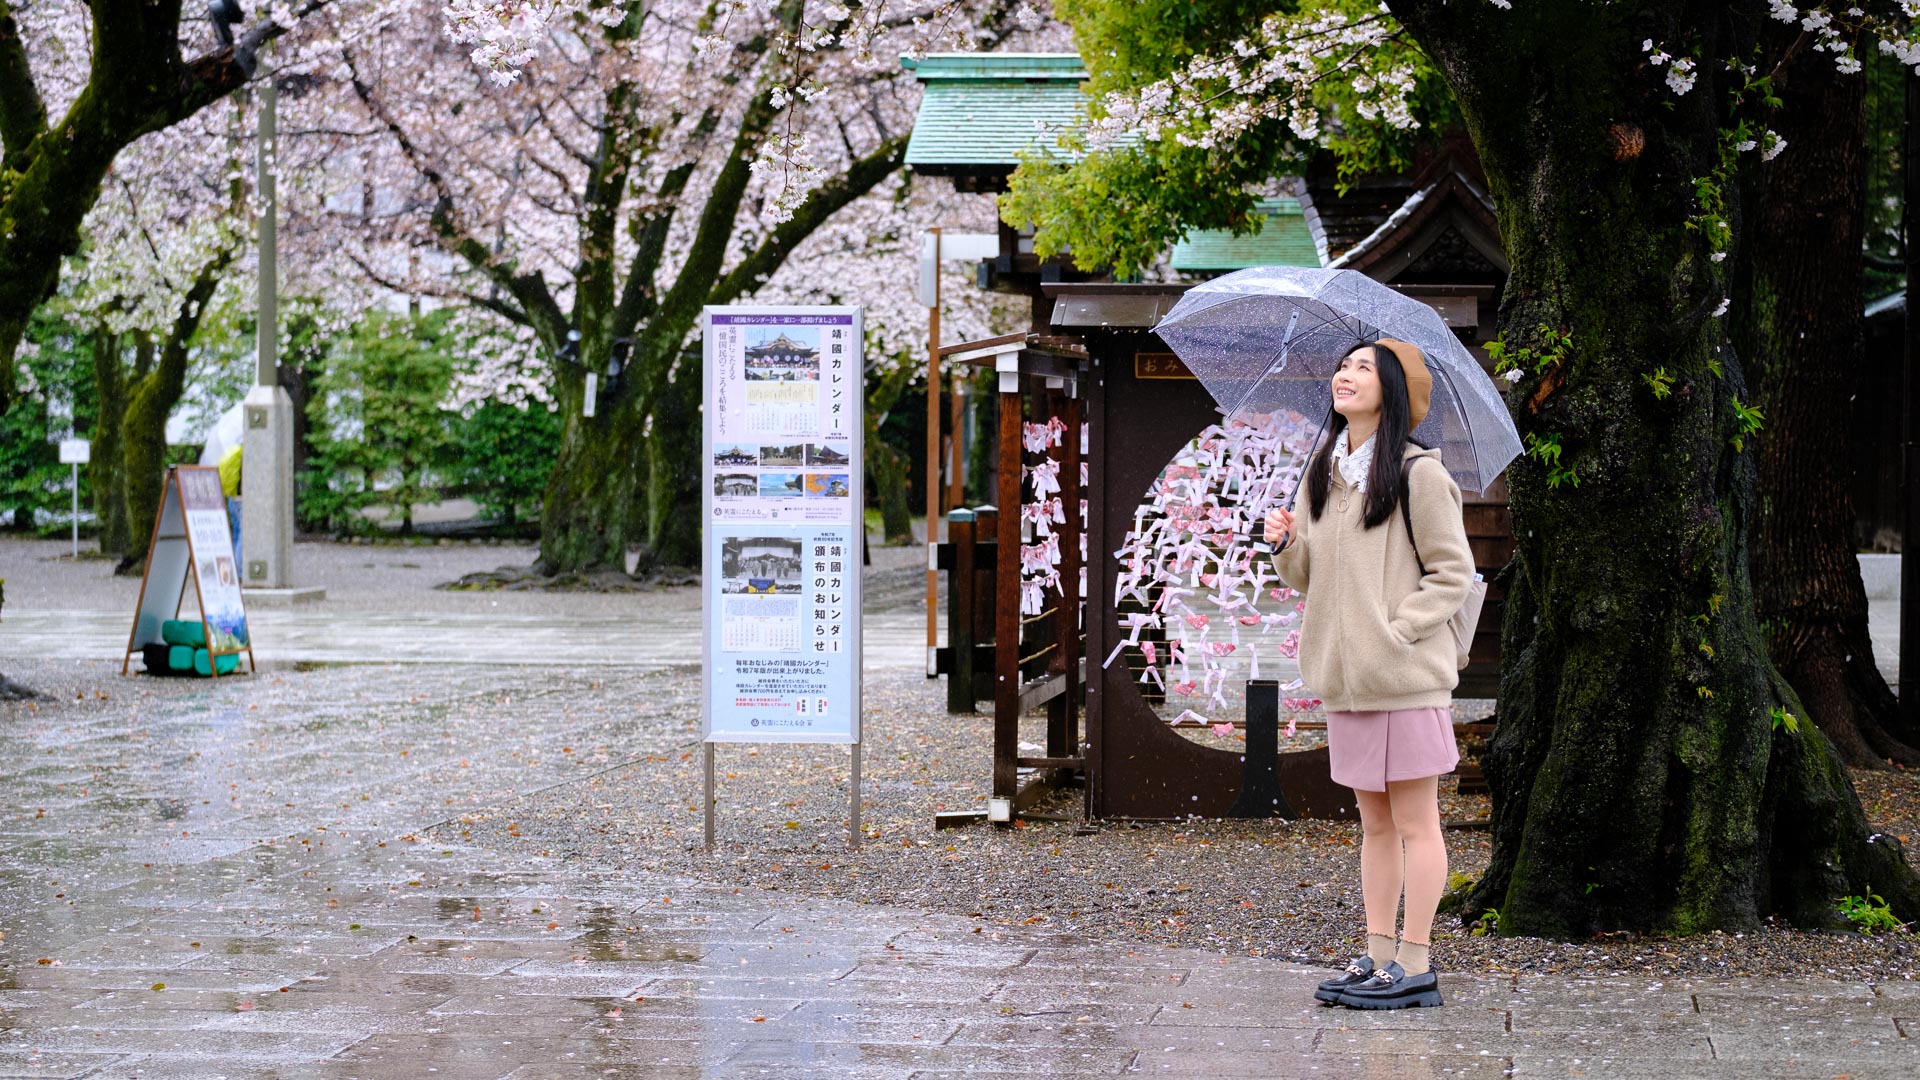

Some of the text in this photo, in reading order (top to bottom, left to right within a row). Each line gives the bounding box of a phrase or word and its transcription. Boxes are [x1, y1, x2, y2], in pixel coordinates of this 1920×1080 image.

[831, 329, 842, 429] 靖國カレンダー
[814, 545, 826, 652] 頒布のお知らせ
[830, 545, 842, 652] 靖國カレンダー
